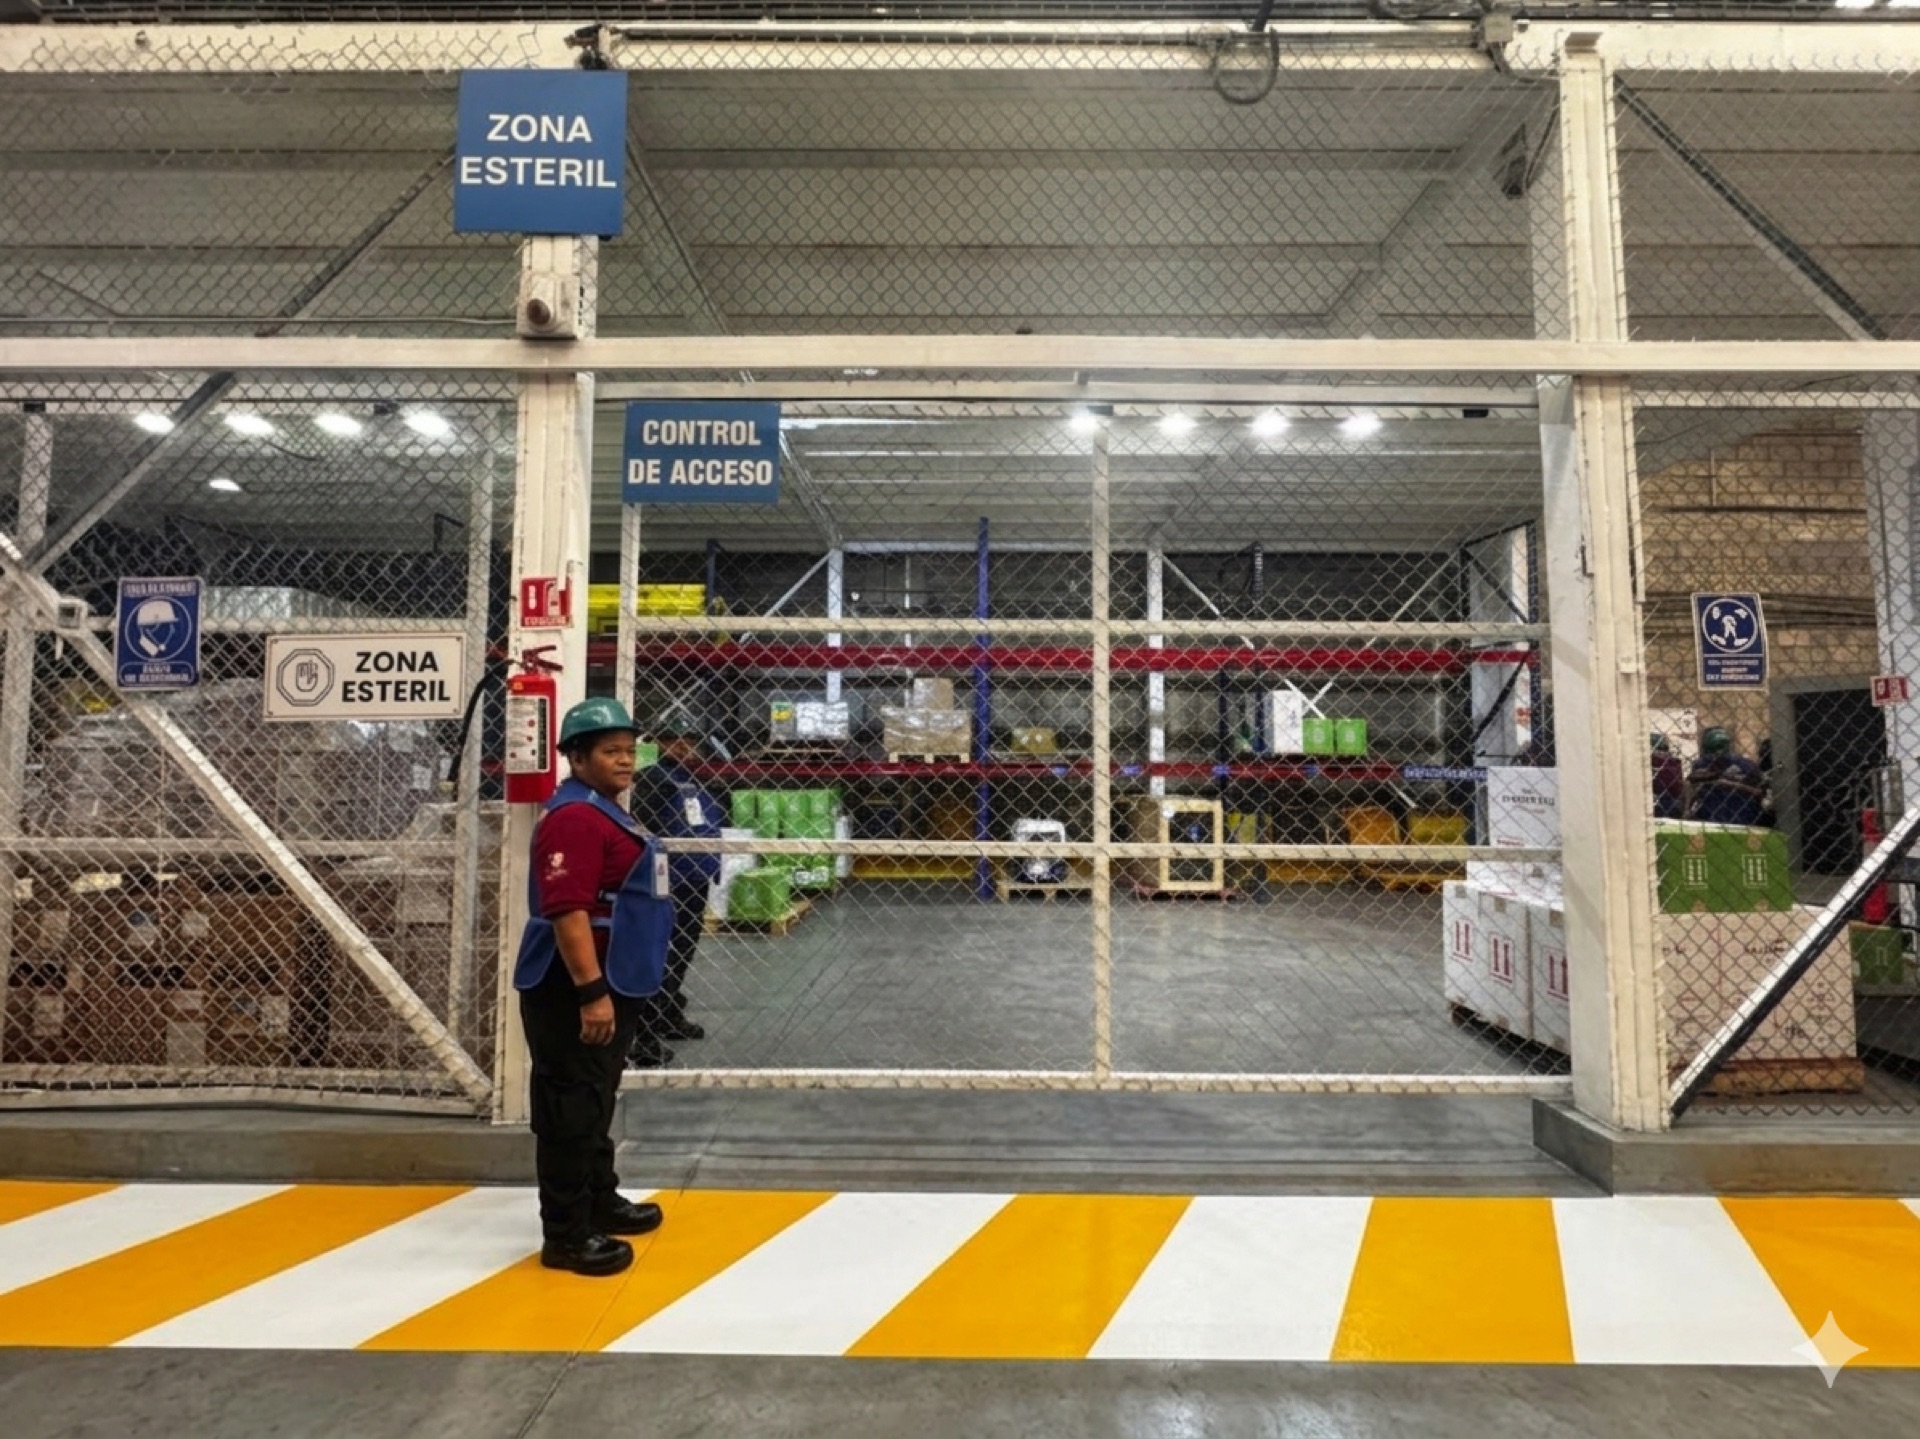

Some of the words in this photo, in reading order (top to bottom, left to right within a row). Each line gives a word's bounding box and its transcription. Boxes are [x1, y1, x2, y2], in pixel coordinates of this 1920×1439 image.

[486, 113, 592, 143] ZONA
[460, 156, 617, 188] ESTERIL
[643, 419, 761, 446] CONTROL
[627, 458, 661, 484] DE
[669, 458, 773, 486] ACCESO
[355, 651, 439, 673] ZONA
[341, 680, 451, 703] ESTERIL
